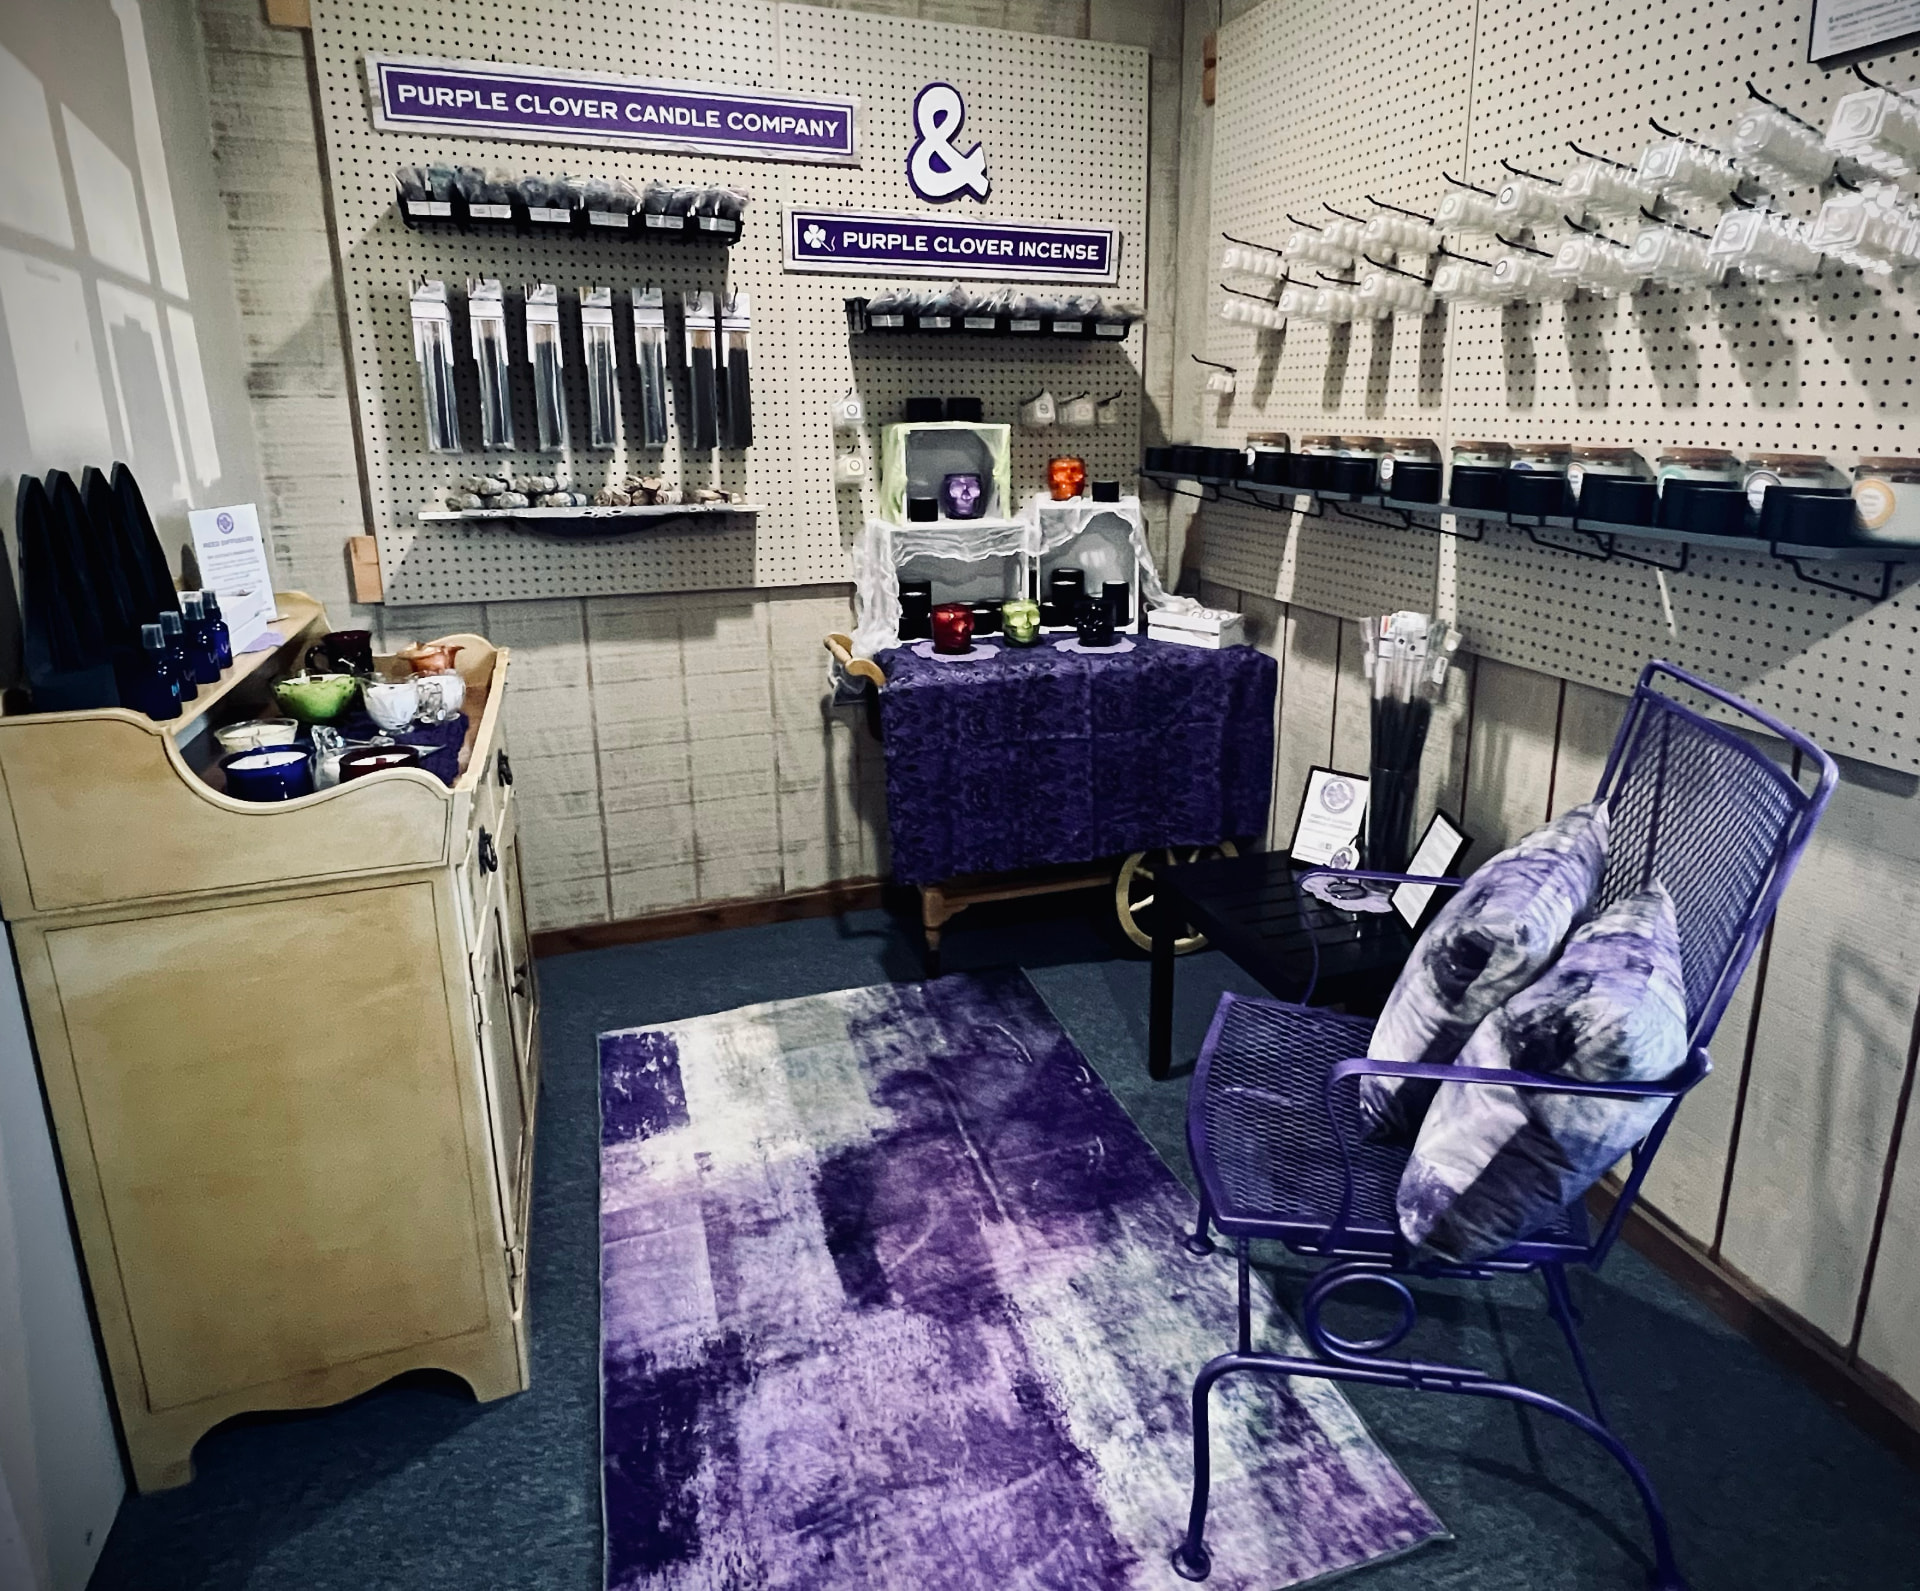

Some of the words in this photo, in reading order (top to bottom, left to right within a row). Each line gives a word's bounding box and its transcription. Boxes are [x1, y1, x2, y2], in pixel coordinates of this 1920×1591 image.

[398, 84, 509, 111] PURPLE
[515, 94, 618, 120] CLOVER
[625, 103, 721, 128] CANDLE
[727, 112, 839, 138] COMPANY
[908, 83, 991, 202] &
[842, 231, 928, 252] PURPLE
[934, 236, 1014, 256] CLOVER
[1018, 241, 1099, 260] INCENSE
